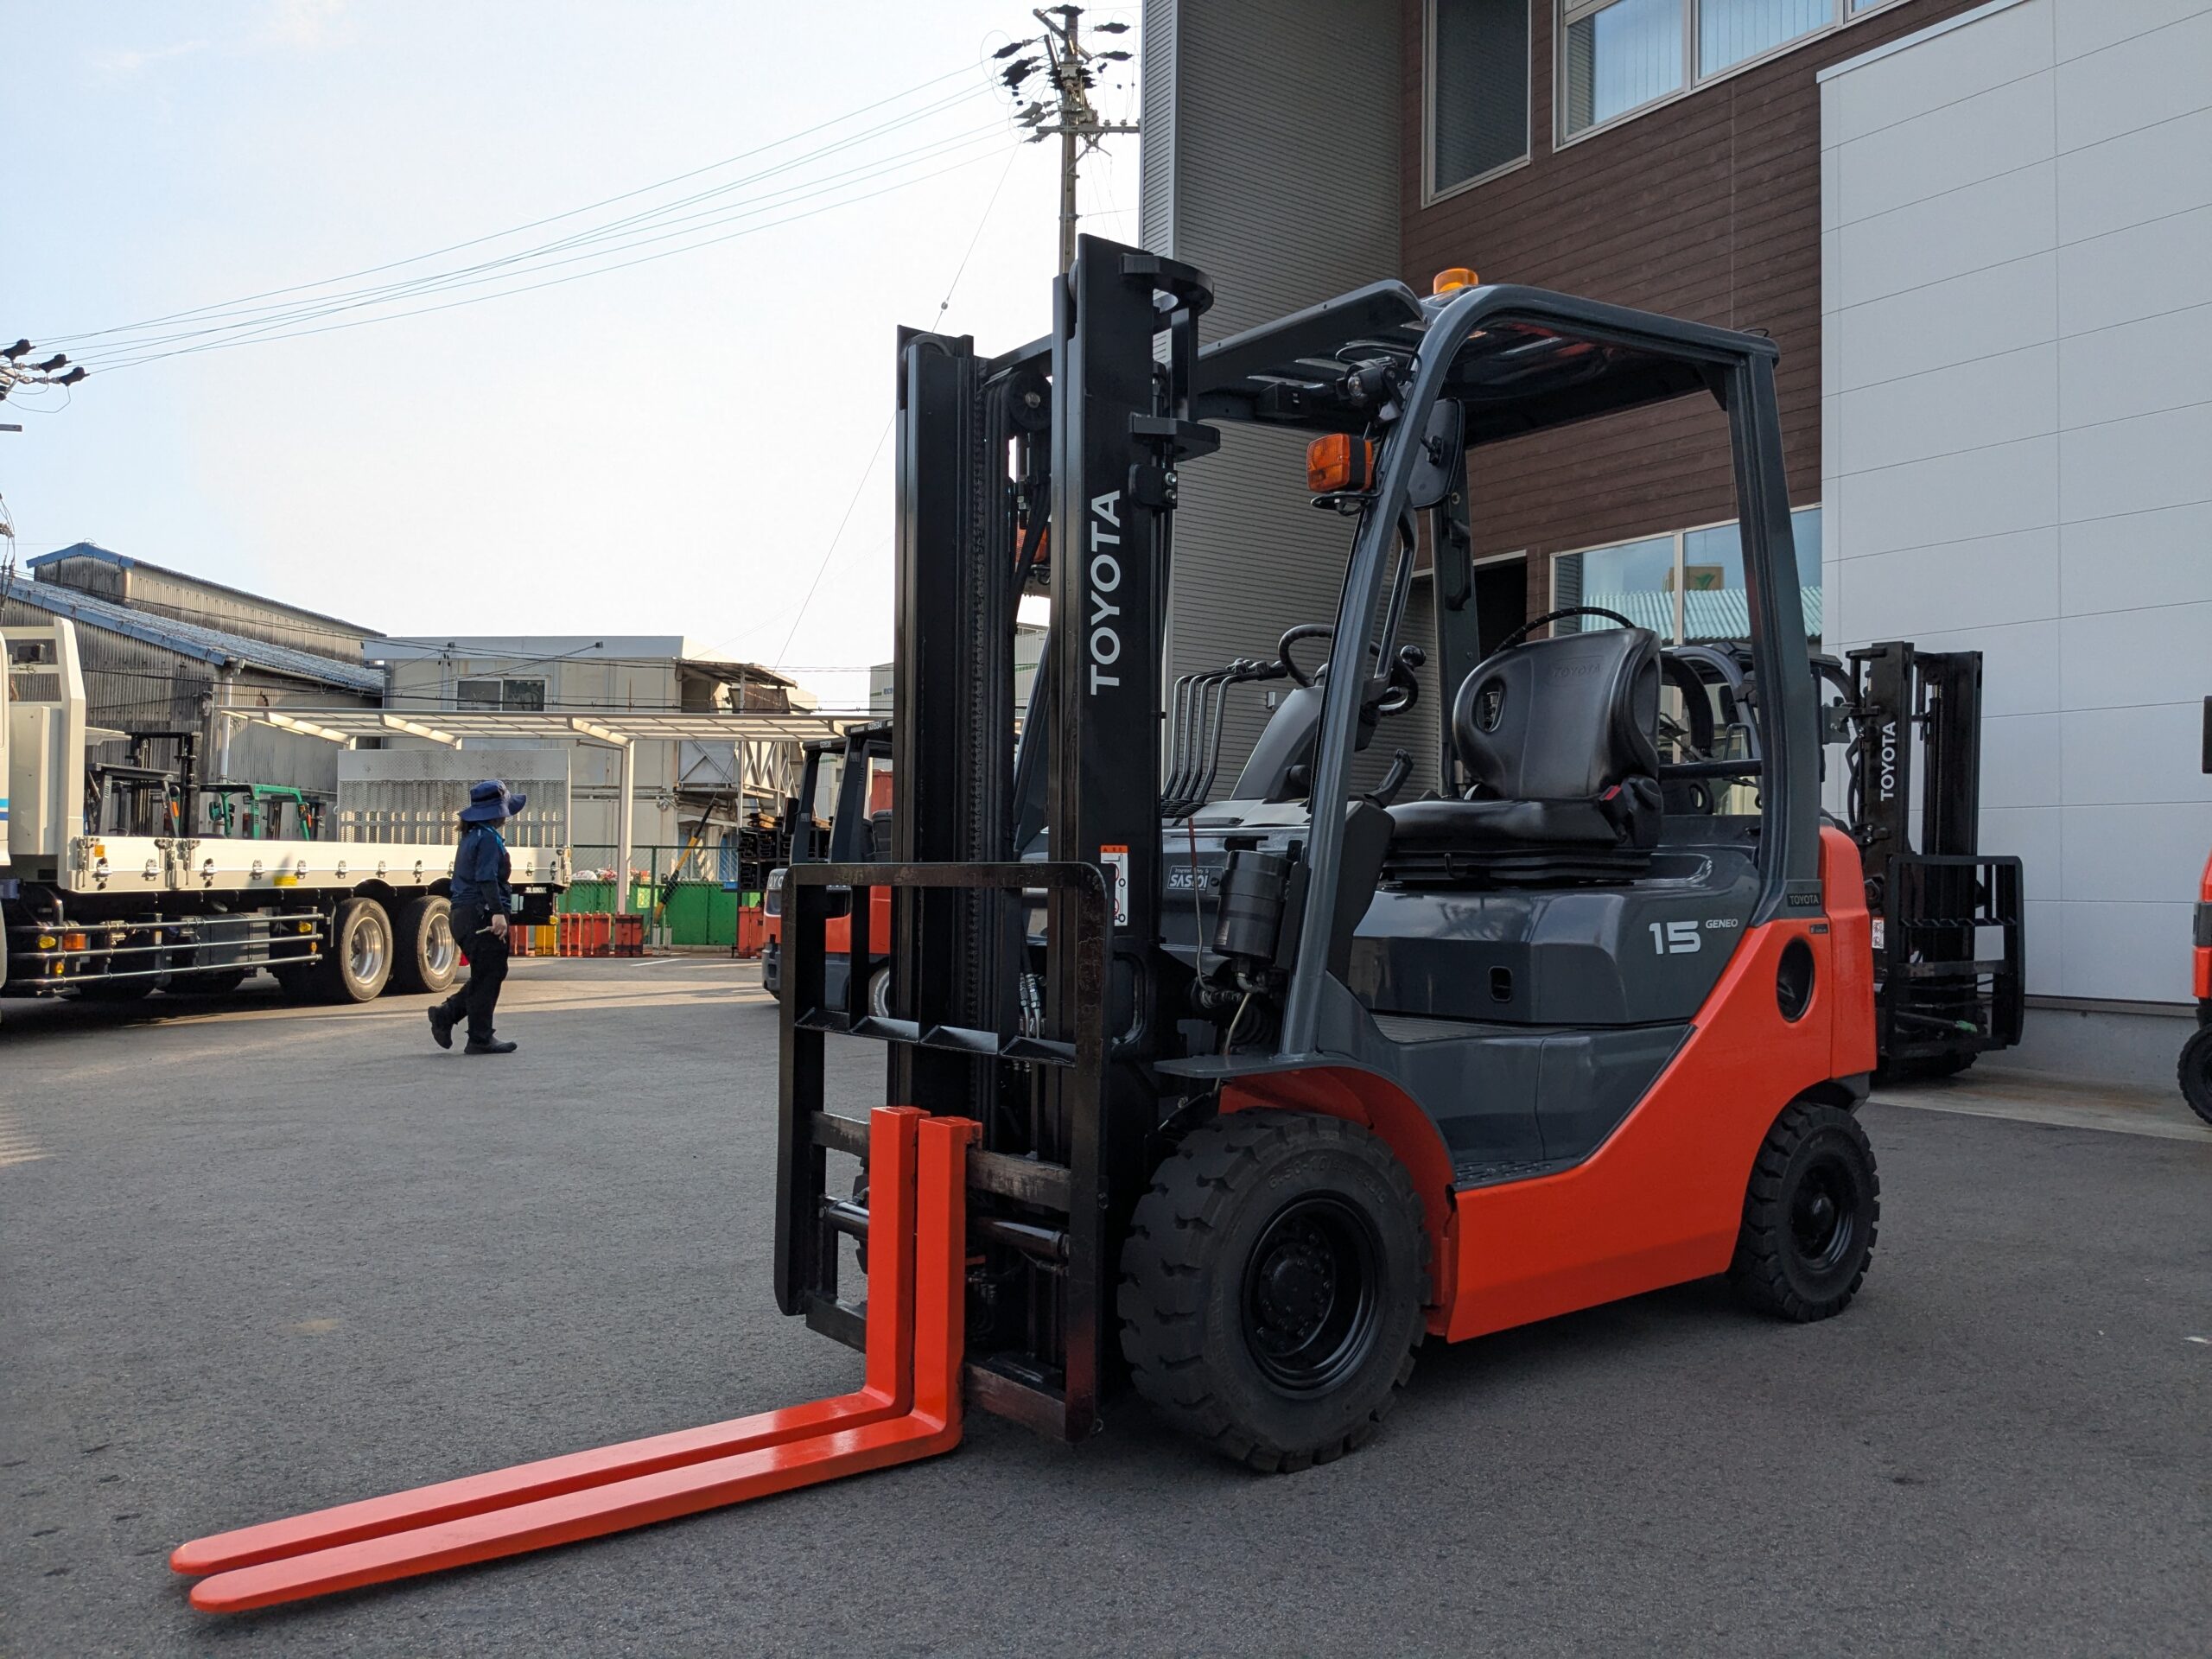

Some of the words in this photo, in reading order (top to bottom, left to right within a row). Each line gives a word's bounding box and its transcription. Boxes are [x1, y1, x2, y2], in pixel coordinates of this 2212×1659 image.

[1090, 490, 1121, 696] TOYOTA
[1552, 663, 1601, 677] TOYOTA
[1880, 721, 1896, 802] TOYOTA
[1789, 894, 1820, 906] TOYOTA
[1705, 918, 1738, 929] GENEO
[1649, 920, 1701, 955] 15
